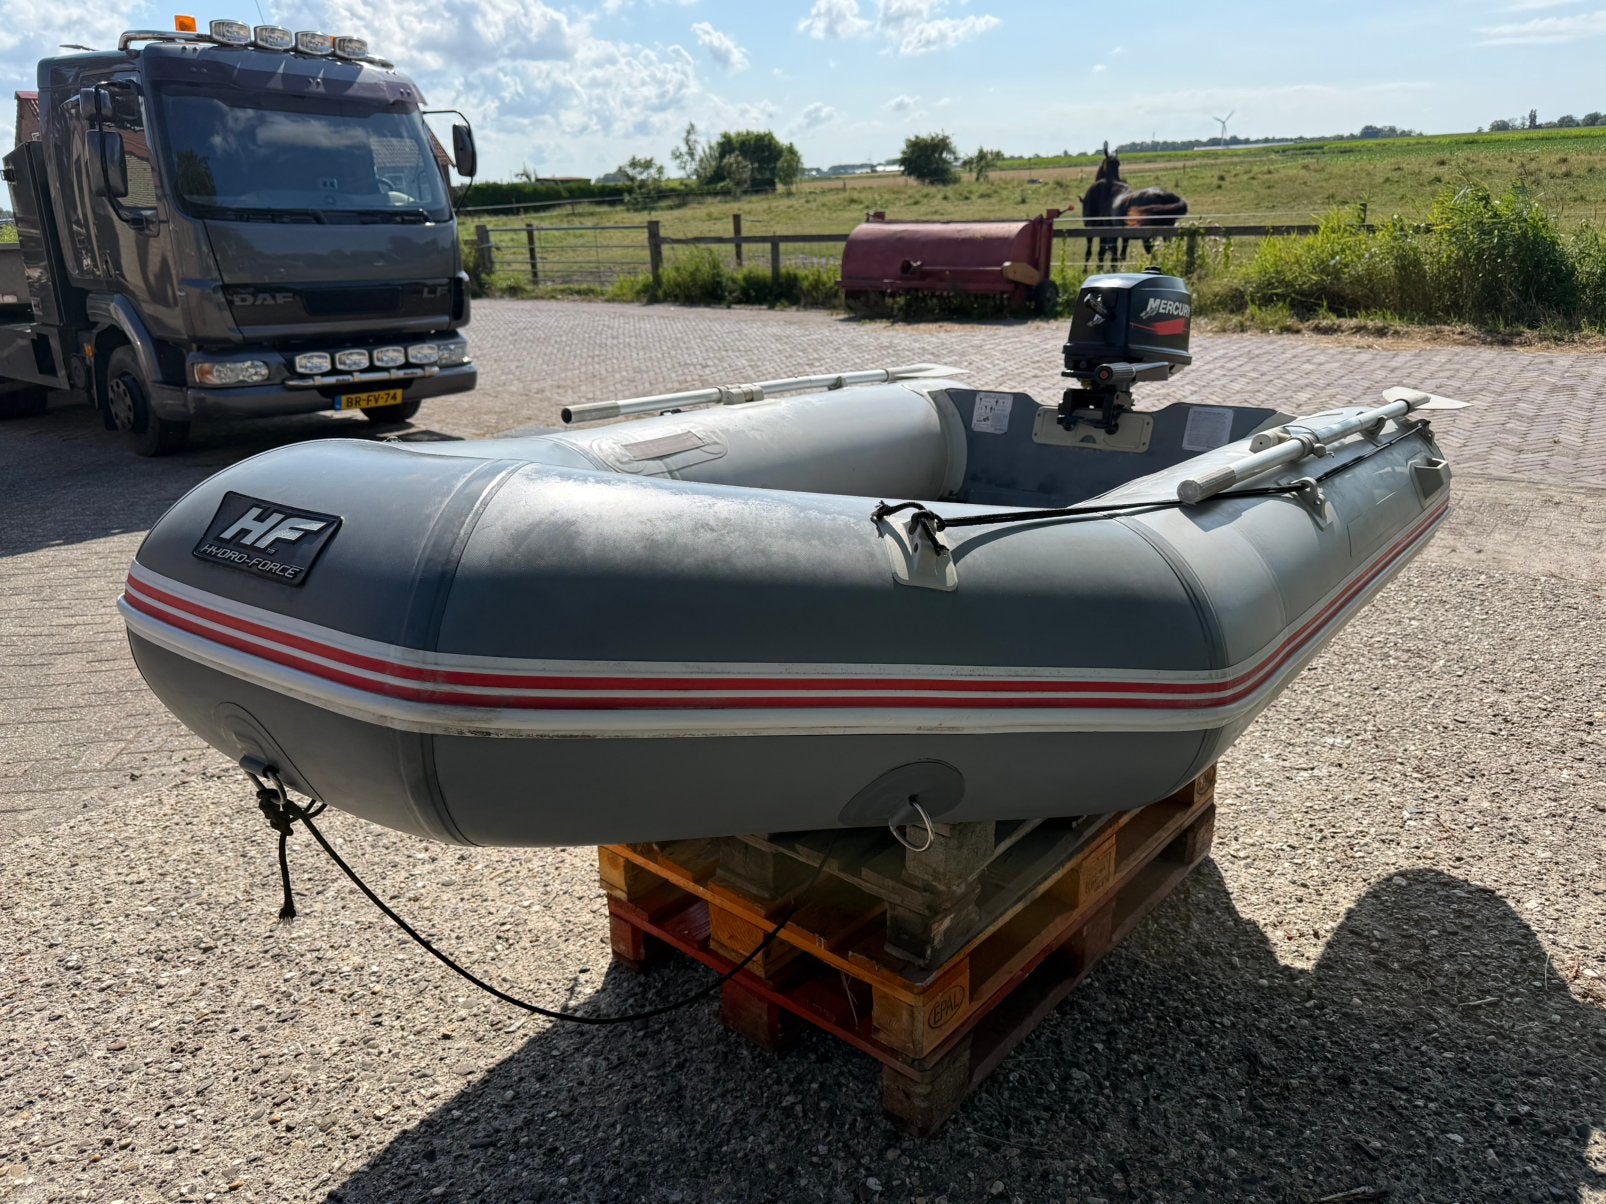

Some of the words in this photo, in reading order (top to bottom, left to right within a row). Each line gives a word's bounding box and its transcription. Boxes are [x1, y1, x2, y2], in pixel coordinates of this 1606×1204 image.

[233, 292, 293, 306] DAF
[423, 286, 448, 298] LF
[346, 392, 398, 408] BR-FV-74
[219, 506, 327, 549] HF
[200, 544, 301, 579] HYDRO-FORCE
[933, 991, 960, 1025] EPAL
